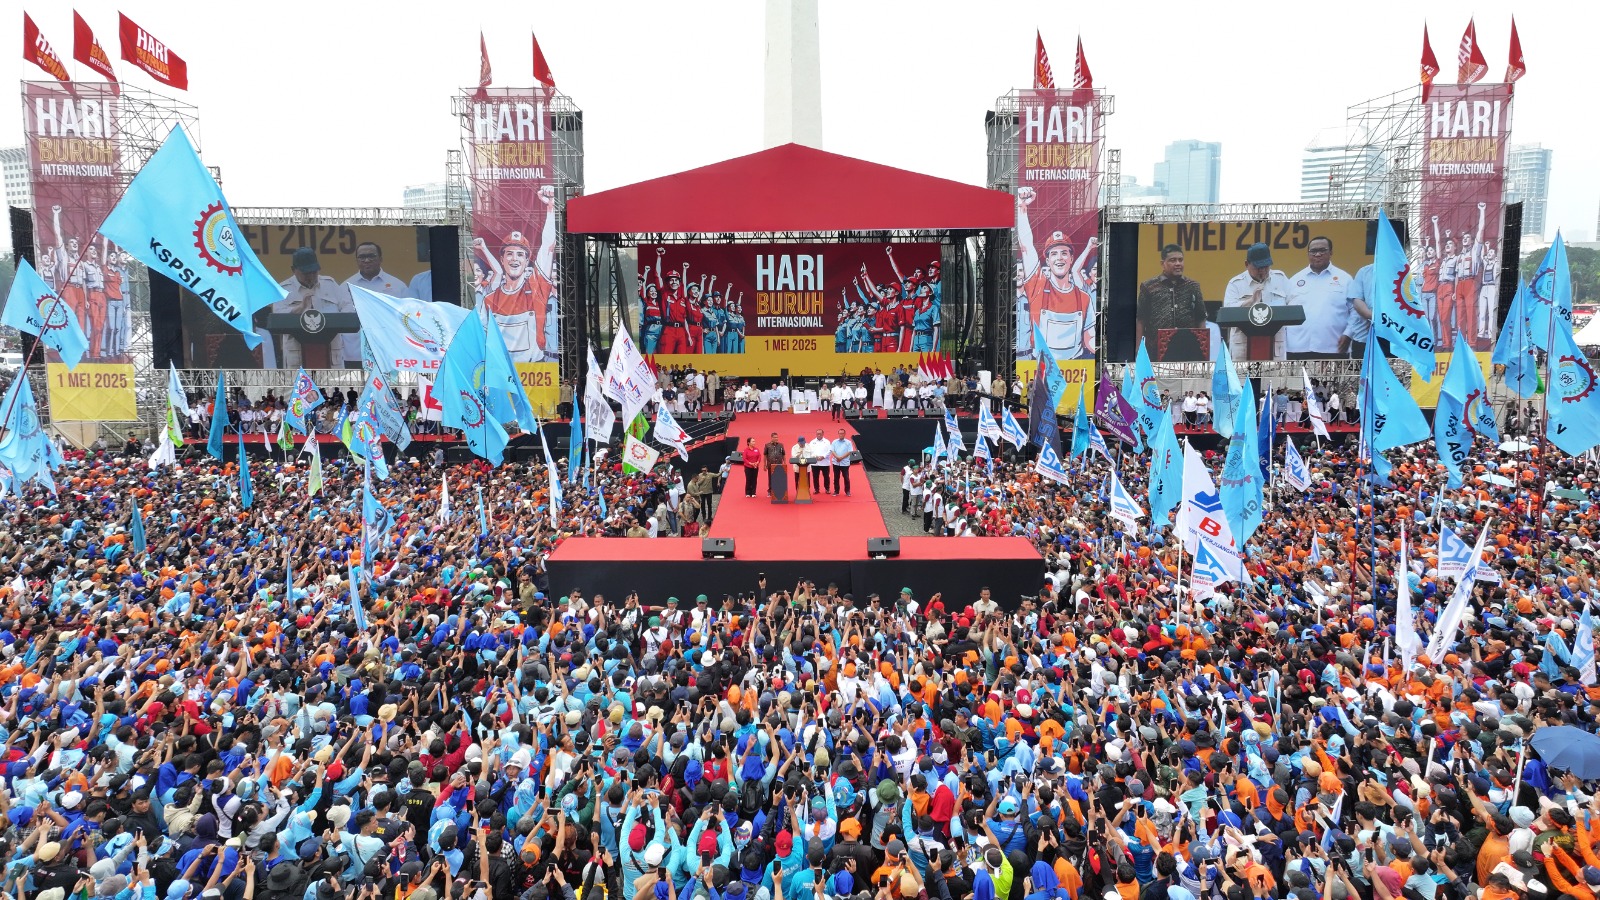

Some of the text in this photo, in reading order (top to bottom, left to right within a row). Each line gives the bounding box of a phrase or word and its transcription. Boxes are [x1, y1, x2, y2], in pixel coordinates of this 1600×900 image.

[137, 28, 169, 65] HARI
[136, 47, 170, 76] BURUH
[36, 98, 111, 137] HARI
[474, 104, 544, 141] HARI
[1025, 106, 1093, 143] HARI
[1431, 101, 1500, 138] HARI
[39, 138, 113, 163] BURUH
[1025, 144, 1093, 168] BURUH
[1430, 138, 1497, 162] BURUH
[41, 163, 114, 177] INTERNASIONAL
[478, 168, 546, 180] INTERNASIONAL
[1026, 169, 1091, 181] INTERNASIONAL
[1429, 163, 1495, 175] INTERNASIONAL
[278, 225, 357, 255] 2025
[1177, 222, 1226, 251] MEI
[1236, 222, 1310, 249] 2025
[149, 237, 241, 322] KSPSI AGN
[756, 254, 824, 291] HARI
[756, 292, 824, 315] BURUH
[757, 316, 824, 328] INTERNASIONAL
[765, 339, 817, 351] 1 MEI 2025
[395, 359, 443, 369] FSP LE
[57, 372, 128, 388] 1 MEI 2025
[520, 371, 552, 387] 2025
[1479, 414, 1496, 429] AGN
